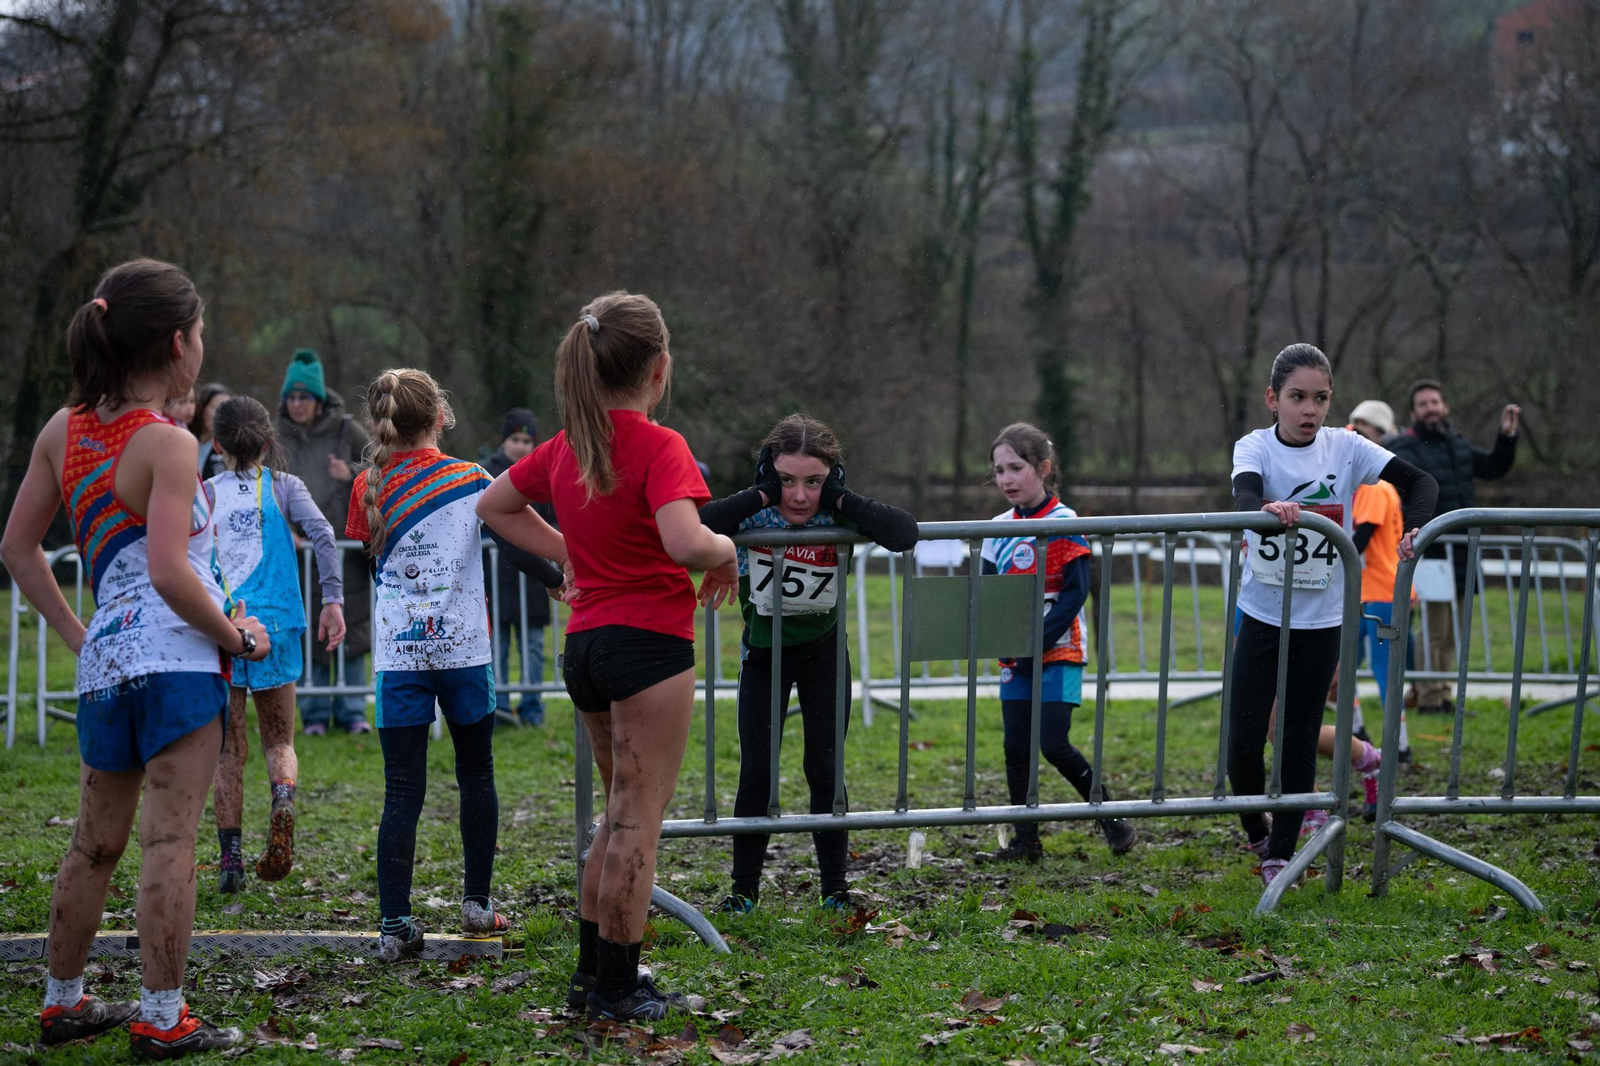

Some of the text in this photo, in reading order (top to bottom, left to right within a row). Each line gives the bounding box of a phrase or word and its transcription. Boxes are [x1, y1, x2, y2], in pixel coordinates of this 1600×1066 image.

[405, 550, 431, 558] GALEGA
[418, 542, 439, 550] RURAL
[1258, 533, 1338, 566] 584
[756, 559, 834, 600] 757
